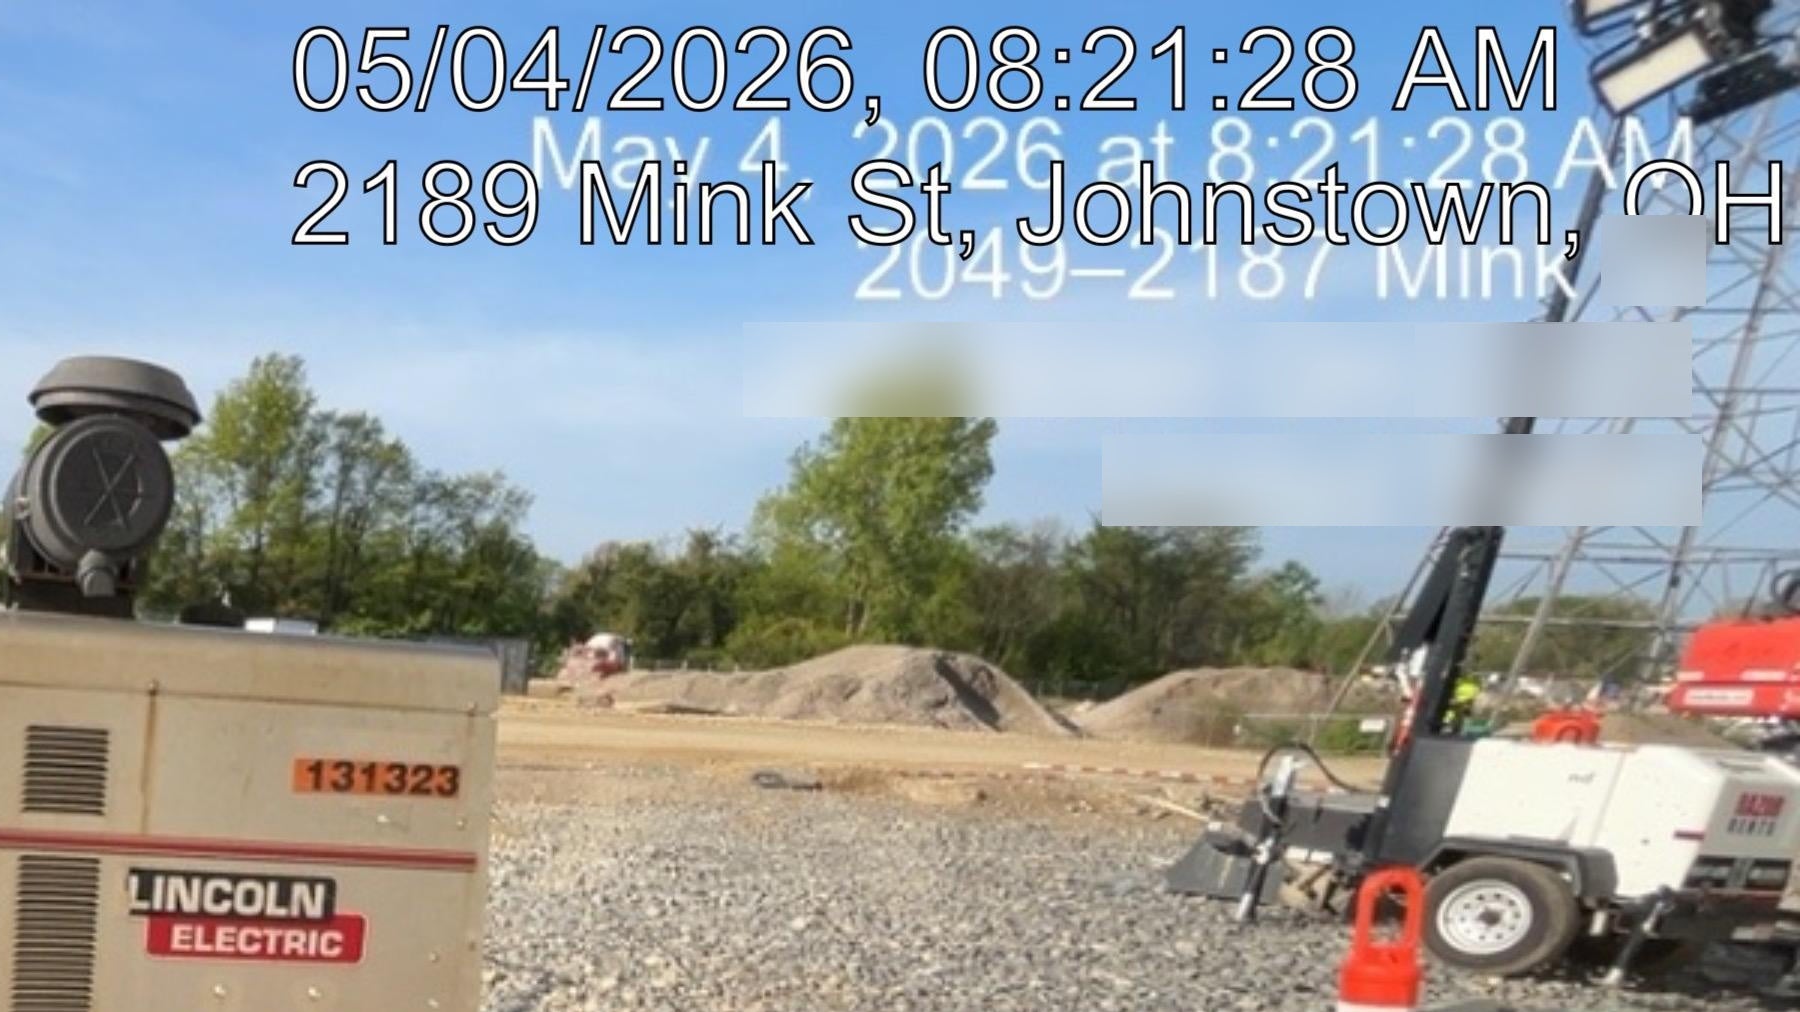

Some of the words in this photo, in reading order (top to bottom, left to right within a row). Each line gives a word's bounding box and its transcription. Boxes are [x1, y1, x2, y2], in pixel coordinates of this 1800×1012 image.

[305, 758, 461, 797] 131323
[128, 873, 327, 919] LINCOLN
[169, 922, 345, 958] ELECTRIC
